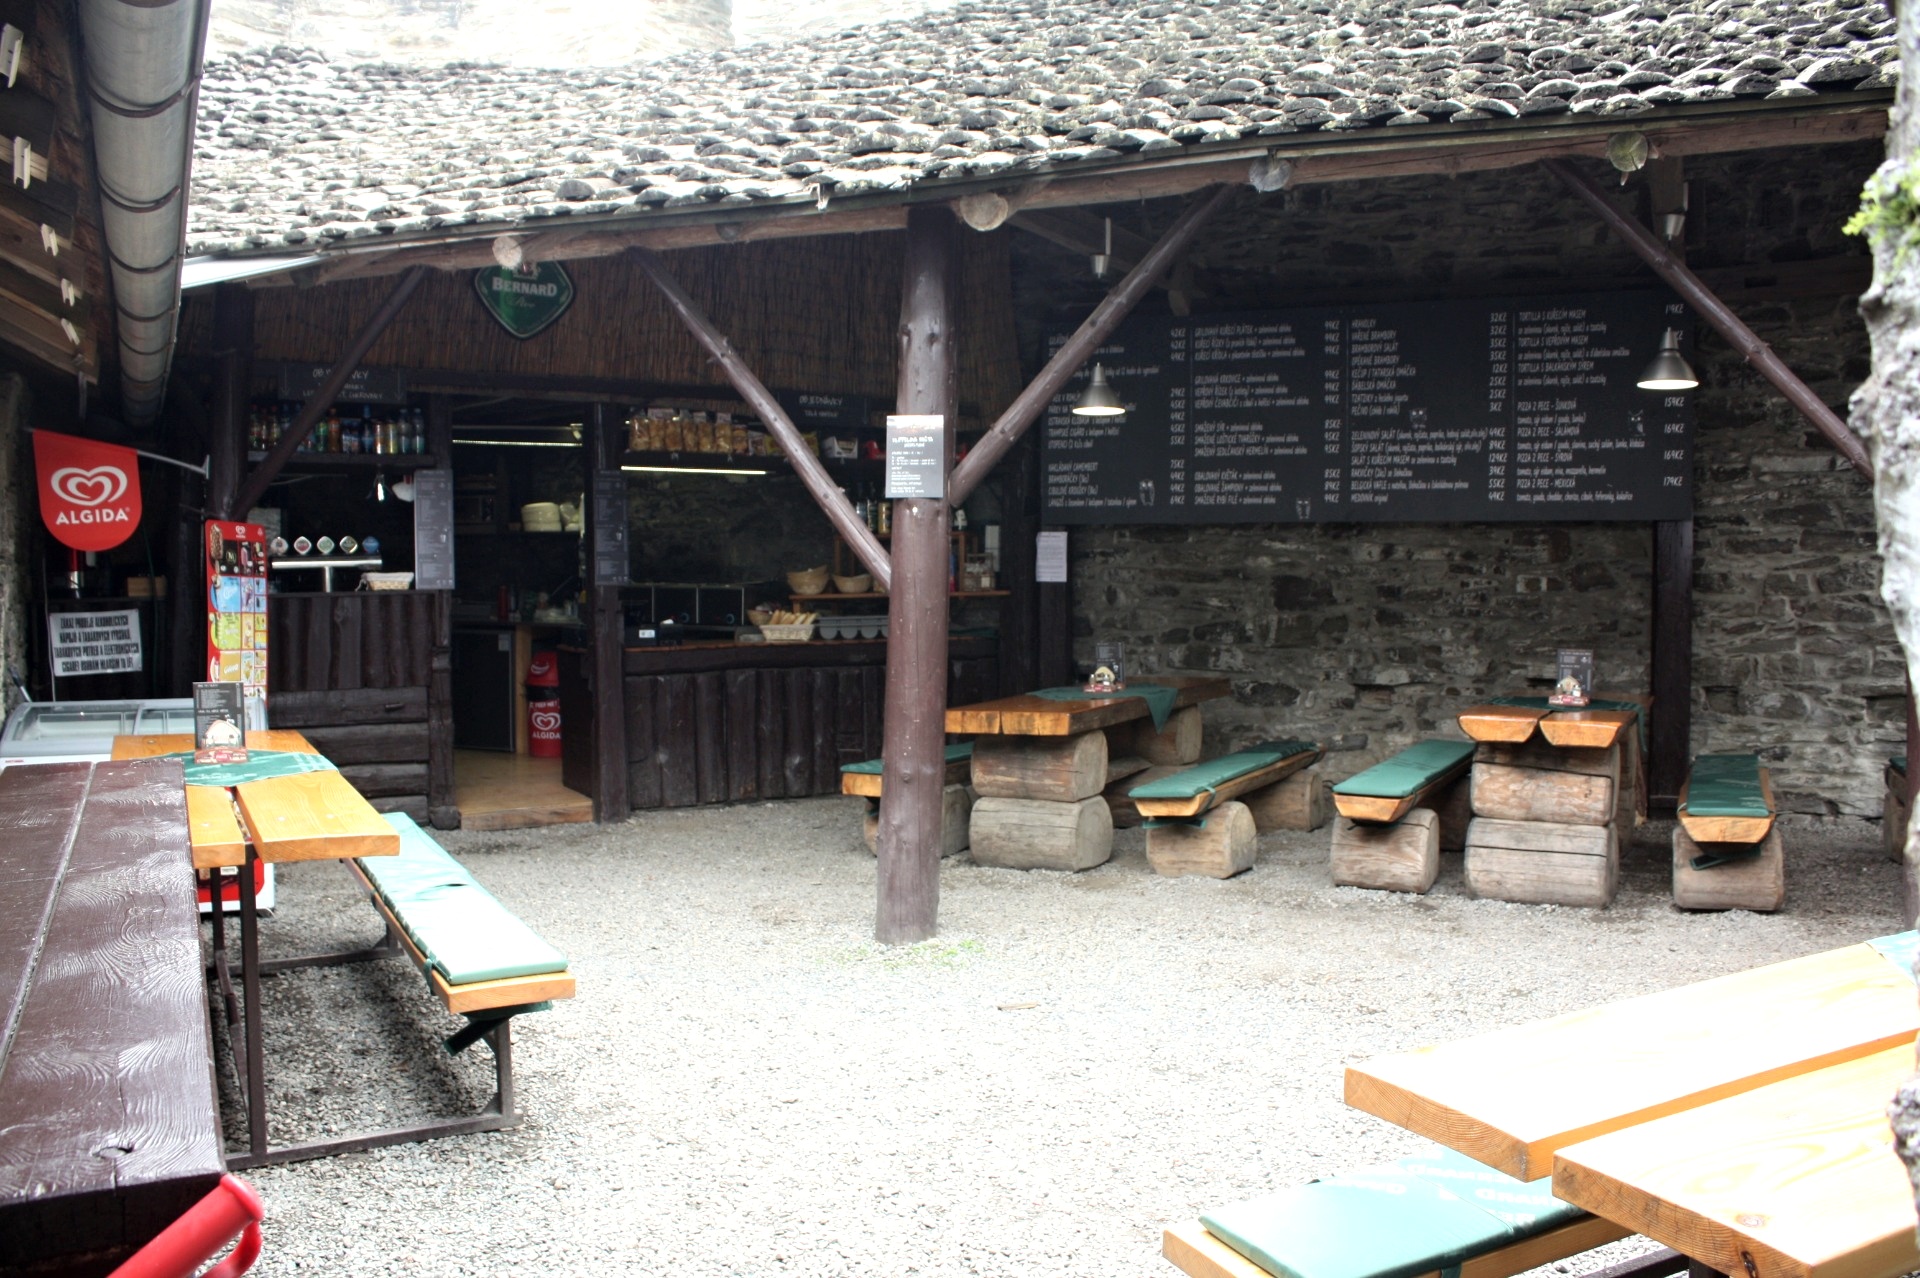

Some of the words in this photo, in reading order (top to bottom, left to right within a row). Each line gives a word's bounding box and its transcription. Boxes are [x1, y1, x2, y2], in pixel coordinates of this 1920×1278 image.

[492, 276, 558, 298] BERNARD
[55, 507, 129, 525] ALGIDA
[532, 731, 562, 740] ALGIDA
